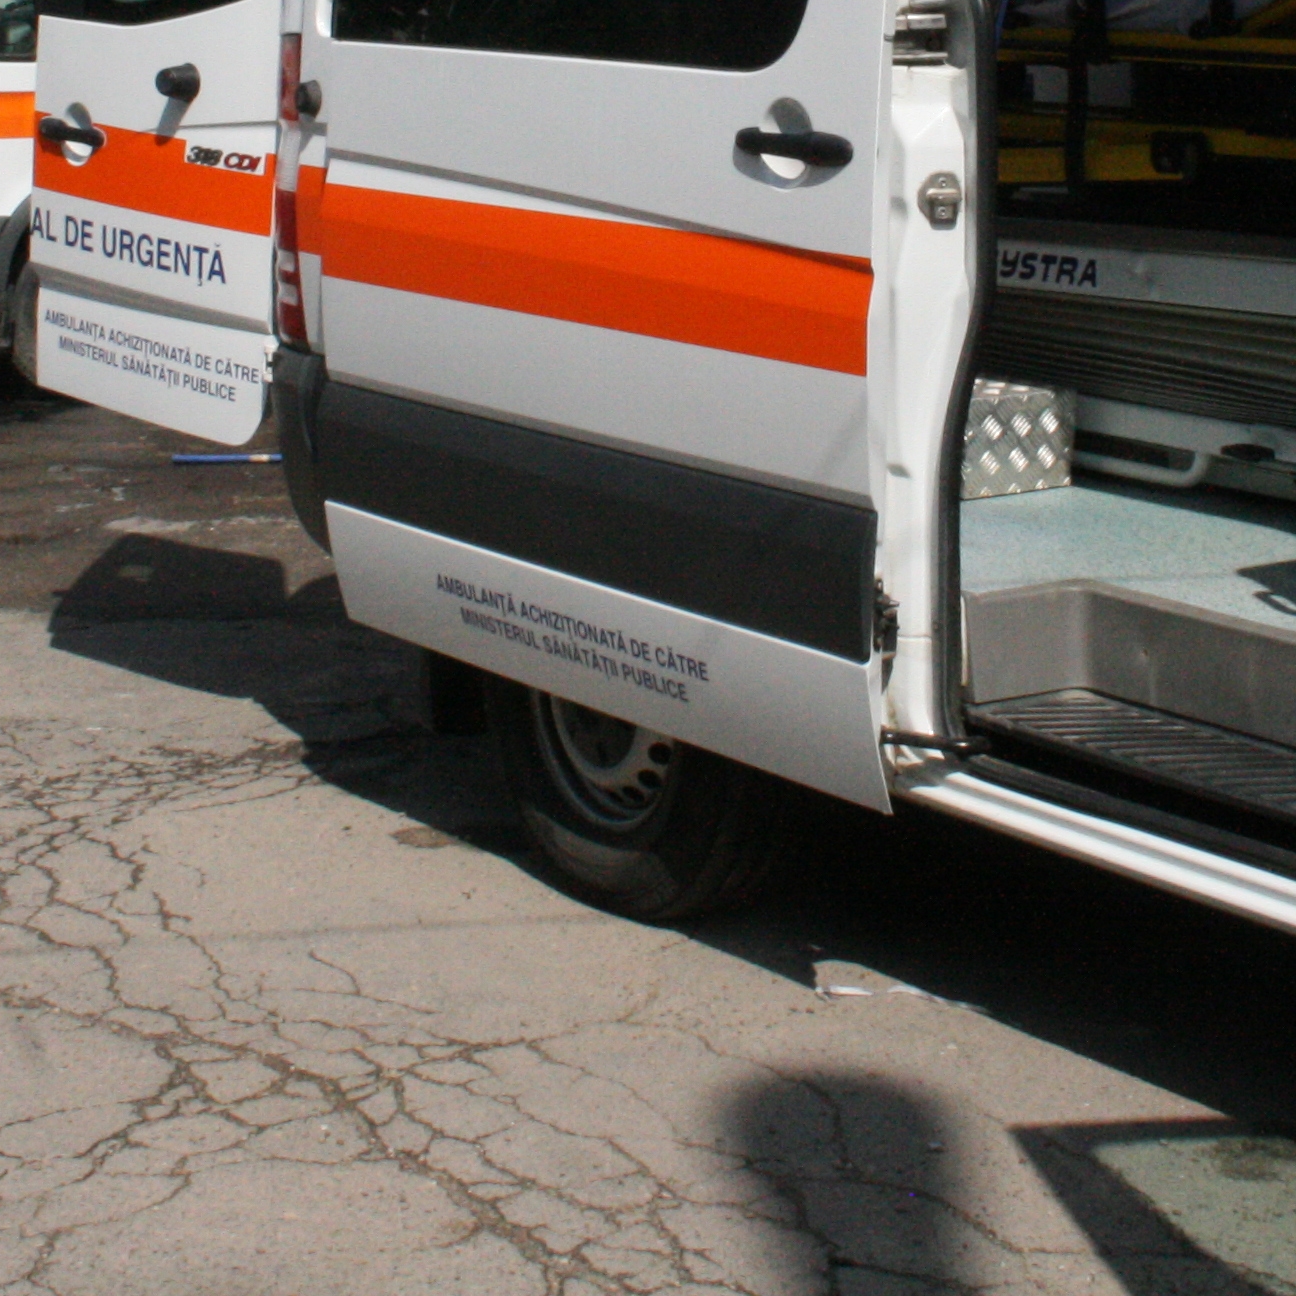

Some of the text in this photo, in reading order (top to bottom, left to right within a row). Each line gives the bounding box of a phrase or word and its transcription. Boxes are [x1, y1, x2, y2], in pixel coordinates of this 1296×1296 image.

[224, 151, 262, 172] CDI
[31, 206, 57, 243] AL
[64, 215, 94, 253] DE
[58, 335, 119, 367] MINISTERUL
[183, 373, 236, 402] PUBLICE
[195, 353, 212, 372] DE
[215, 357, 260, 384] CĂTRE
[460, 606, 541, 650] MINISTERUL
[621, 662, 690, 702] PUBLICE
[630, 638, 652, 662] DE
[655, 646, 710, 682] CĂTRE
